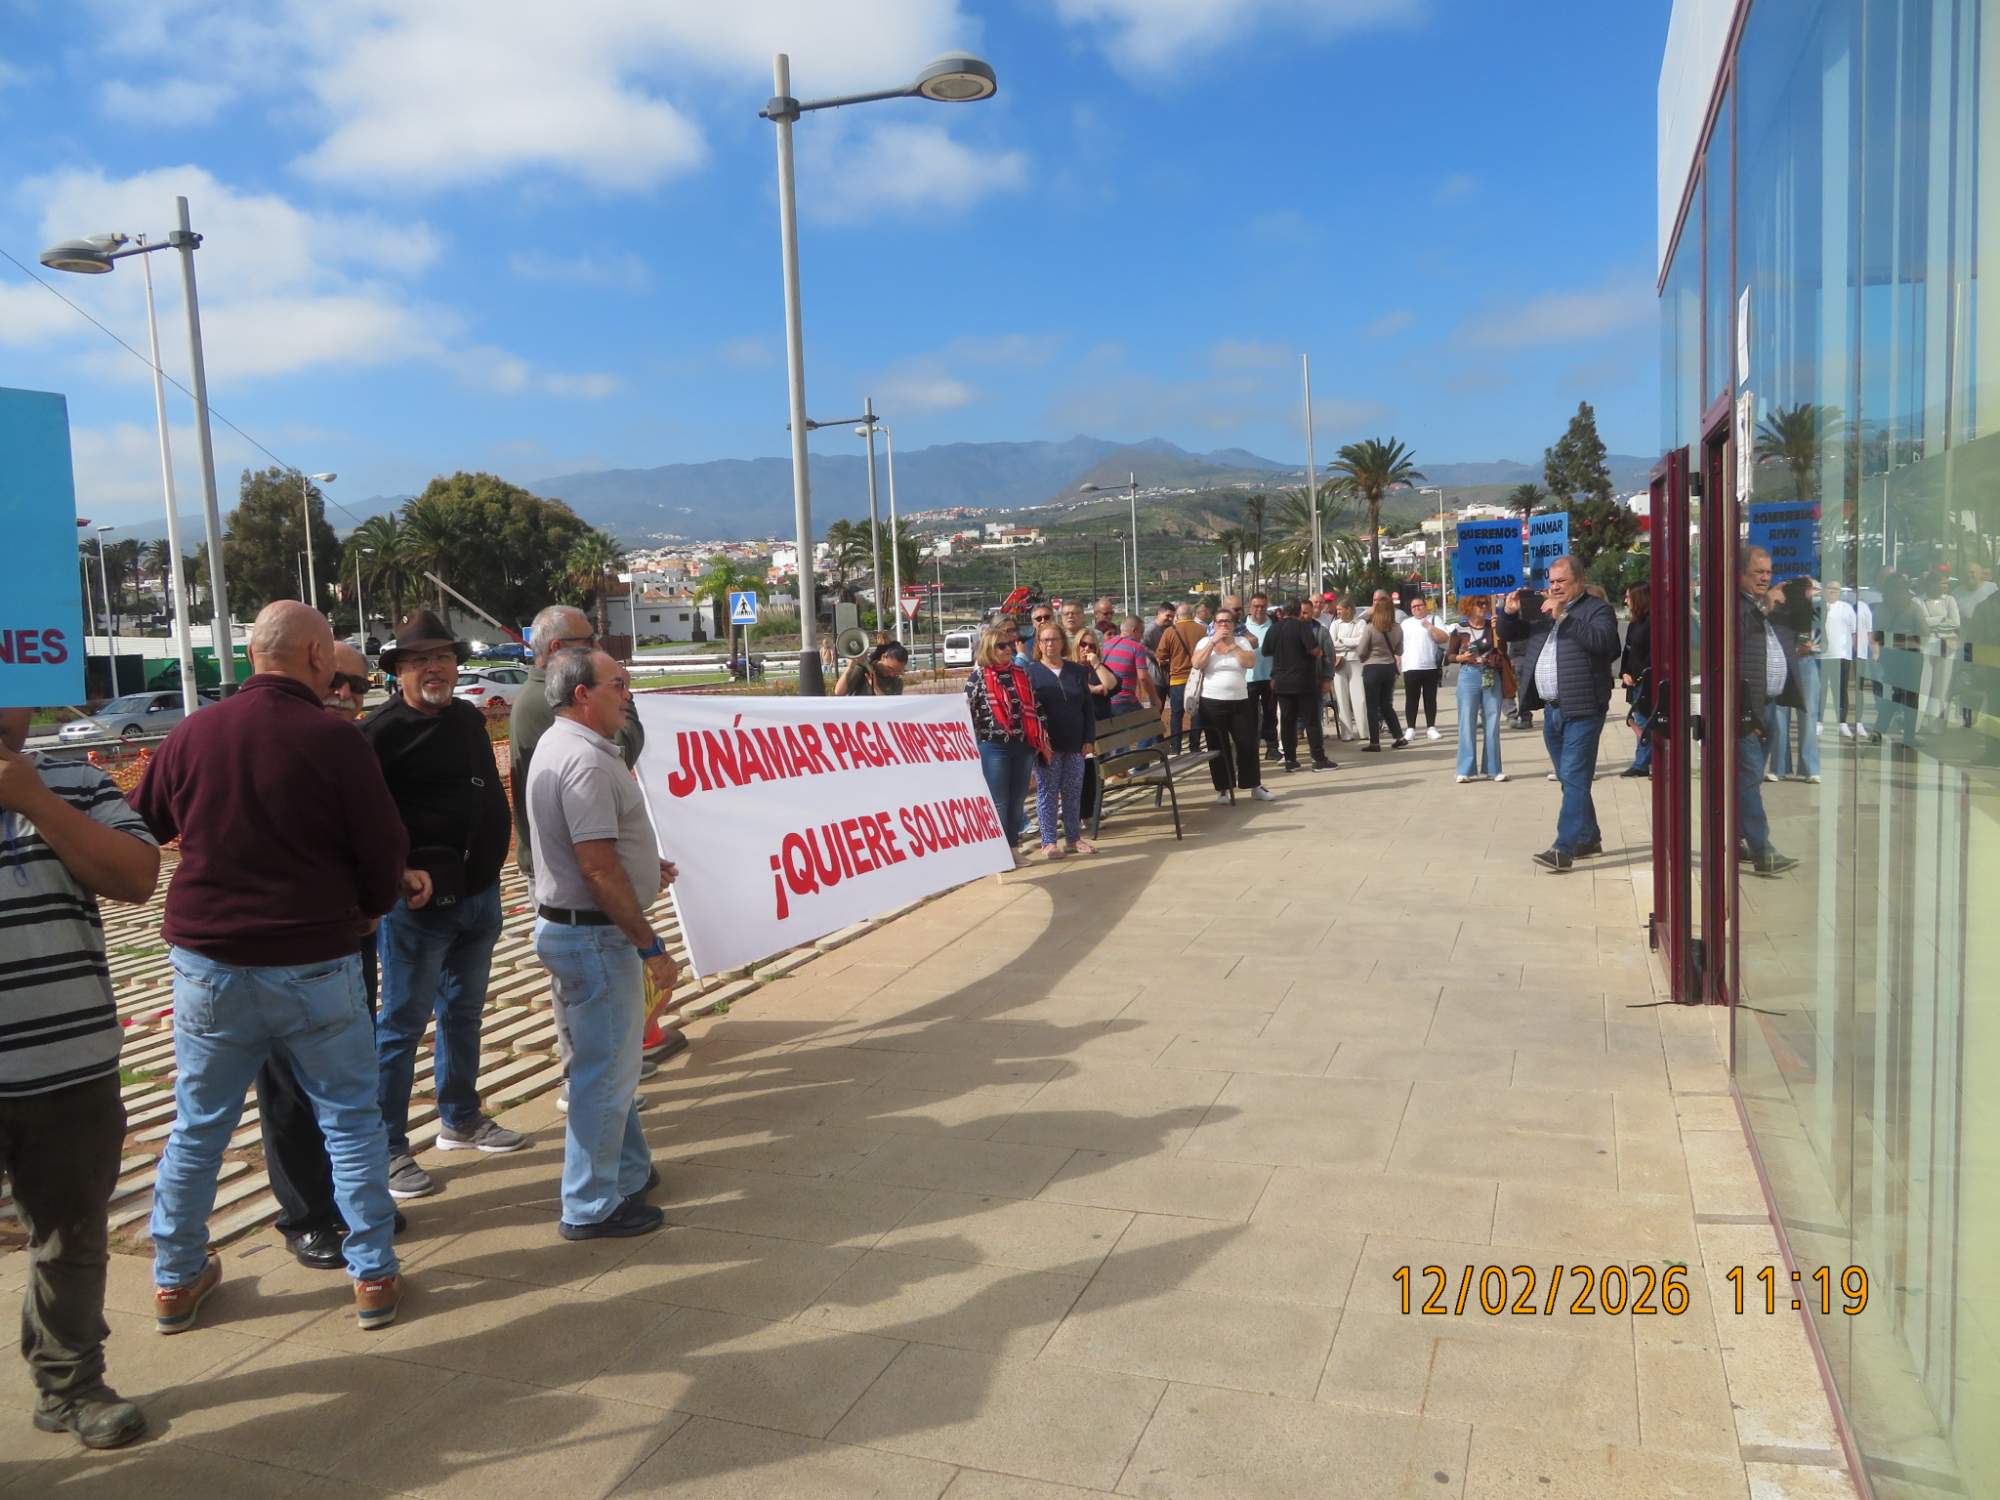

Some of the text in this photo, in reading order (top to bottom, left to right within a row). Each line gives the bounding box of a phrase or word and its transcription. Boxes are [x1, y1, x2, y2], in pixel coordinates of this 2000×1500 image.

[1459, 527, 1518, 540] QUEREMOS
[1530, 518, 1563, 536] JINÁMAR
[1474, 544, 1504, 555] VIVIR
[1530, 541, 1563, 558] TAMBIÉN
[1478, 560, 1500, 571] CON
[1464, 575, 1516, 588] DIGNIDAD
[667, 713, 980, 798] JINÁMAR PAGA IMPUESTOS
[769, 812, 907, 921] ¡QUIERE
